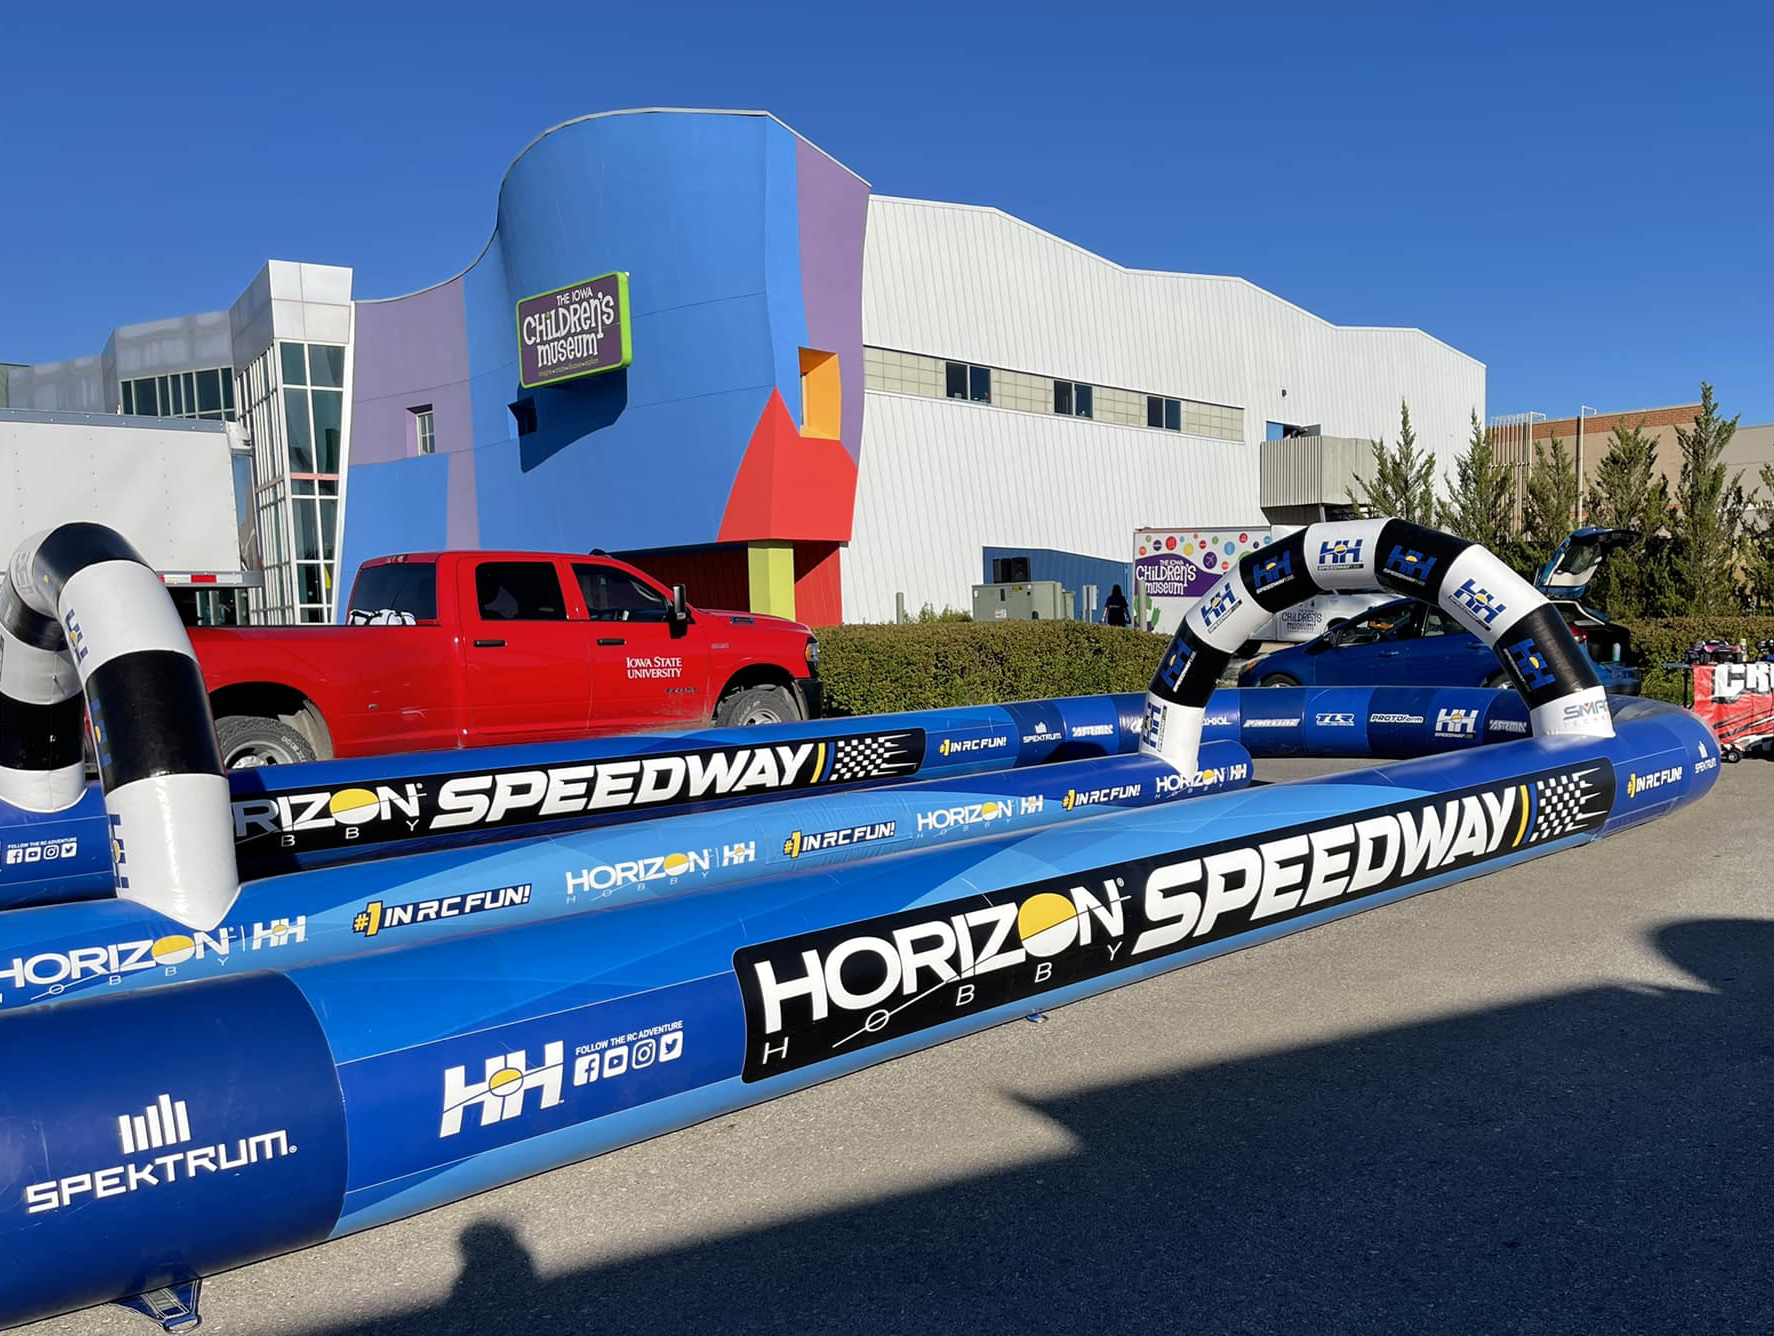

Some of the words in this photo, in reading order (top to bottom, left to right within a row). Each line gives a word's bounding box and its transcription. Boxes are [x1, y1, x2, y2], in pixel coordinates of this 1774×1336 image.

[556, 292, 570, 306] THE
[572, 286, 593, 302] IOWA
[537, 332, 598, 368] museum
[626, 656, 652, 669] IOWA
[654, 656, 682, 668] STATE
[627, 668, 682, 679] UNIVERSITY
[1714, 662, 1774, 701] CR
[980, 736, 1006, 748] FUN!
[232, 782, 420, 838] RIZON
[429, 742, 815, 830] SPEEDWAY
[1661, 766, 1683, 786] FUN!
[1075, 793, 1088, 806] IN
[1089, 790, 1109, 803] RC
[1109, 784, 1141, 801] FUN!
[917, 799, 1012, 831] HORIZON
[784, 831, 801, 858] #1
[802, 835, 821, 851] IN
[825, 831, 851, 847] RC
[852, 821, 896, 842] FUN!
[565, 849, 710, 895] HORIZON
[354, 900, 383, 936] #1
[384, 907, 412, 927] IN
[416, 899, 461, 922] RC
[463, 884, 531, 913] FUN!
[754, 878, 1124, 1035] HORIZON
[1131, 785, 1517, 955] SPEEDWAY
[575, 1039, 608, 1056] FOLLOW
[610, 1034, 625, 1047] THE
[626, 1032, 637, 1043] RC
[638, 1019, 684, 1039] ADVENTURE
[26, 1129, 289, 1214] SPEKTRUM
